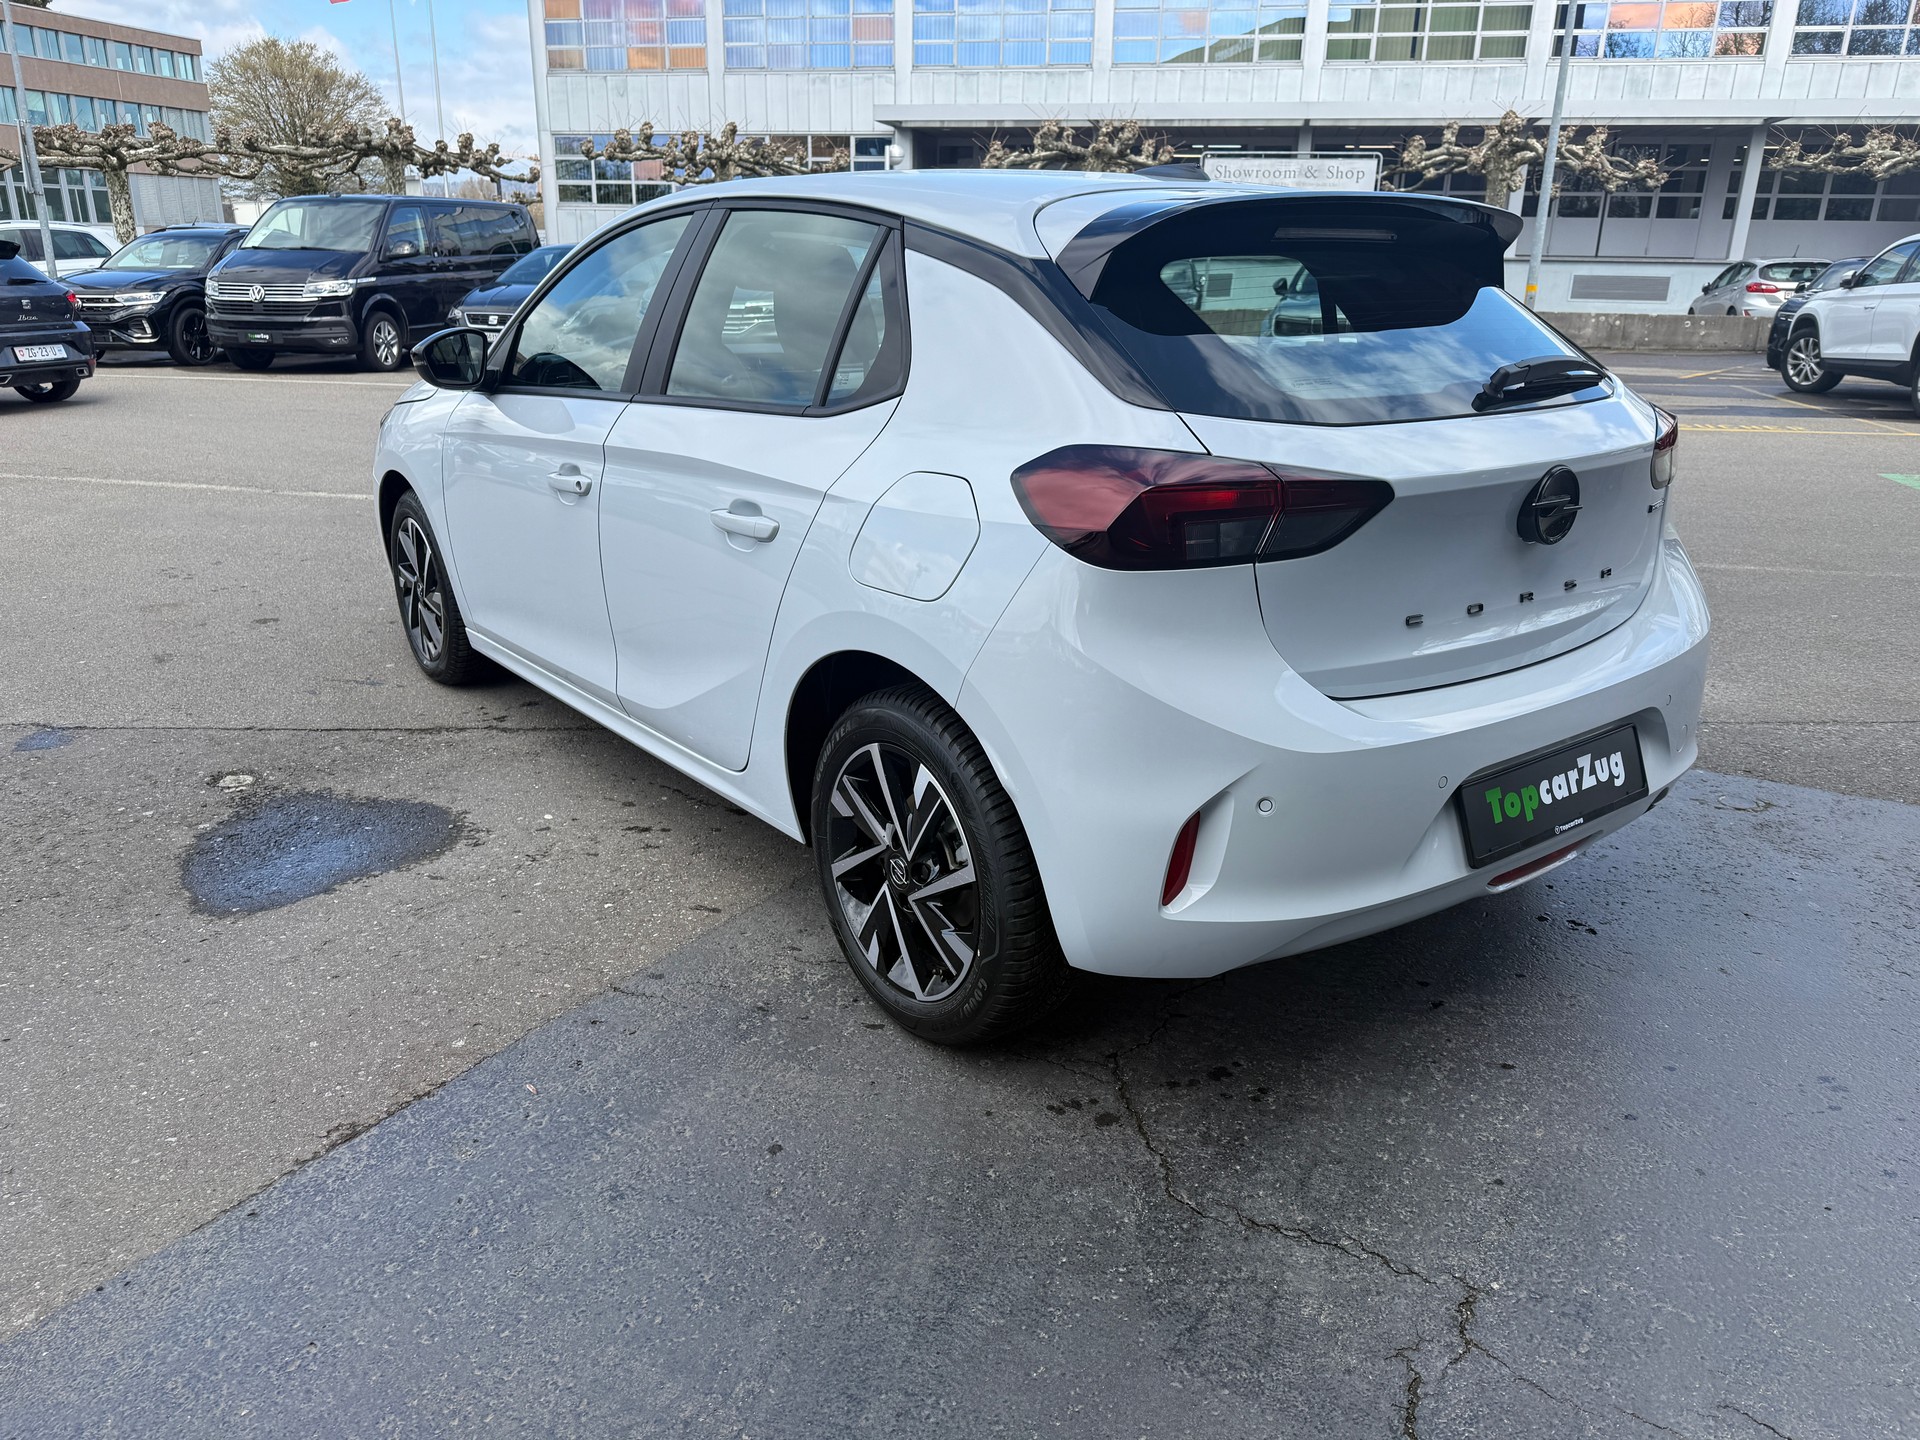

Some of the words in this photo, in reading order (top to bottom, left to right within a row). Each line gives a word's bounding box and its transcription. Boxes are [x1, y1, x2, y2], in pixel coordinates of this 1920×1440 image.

[1214, 164, 1297, 180] Showroom
[1304, 164, 1318, 179] &
[1326, 164, 1366, 184] Shop
[1405, 566, 1613, 627] CORSA
[1484, 751, 1626, 825] TopcarZug
